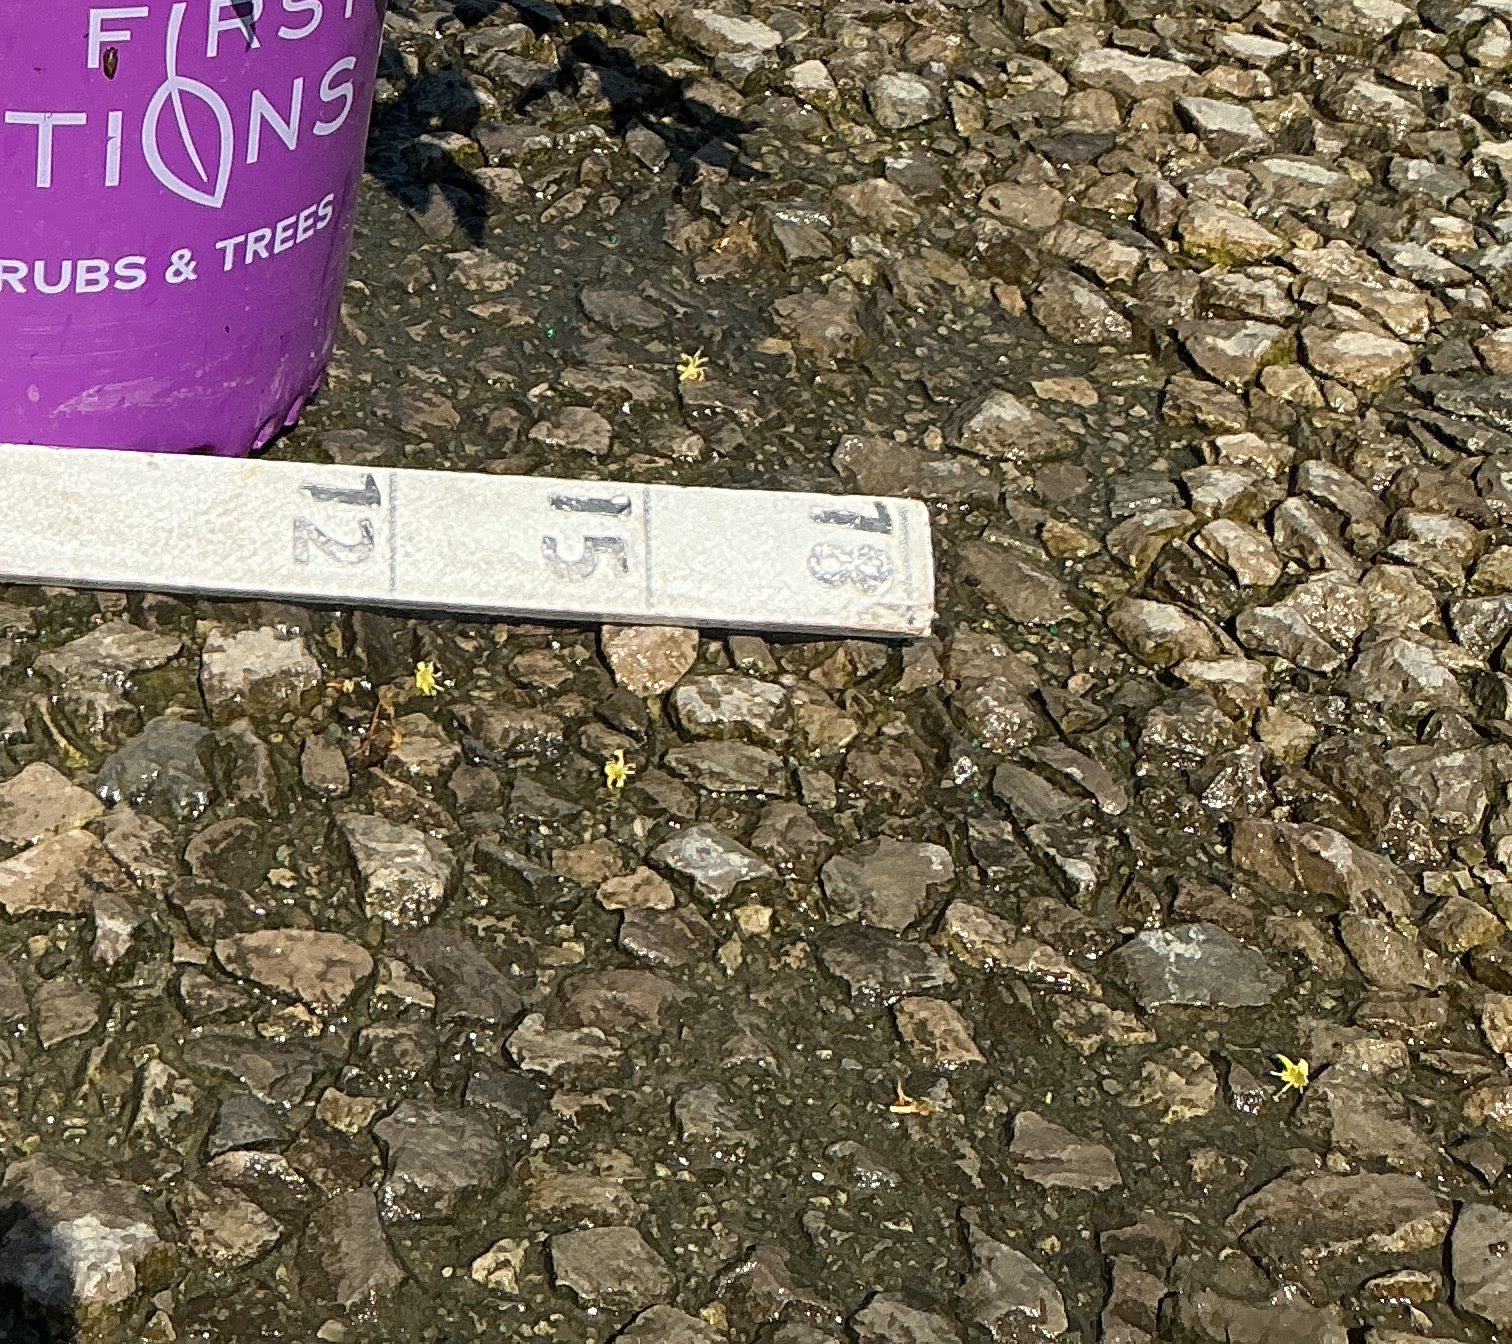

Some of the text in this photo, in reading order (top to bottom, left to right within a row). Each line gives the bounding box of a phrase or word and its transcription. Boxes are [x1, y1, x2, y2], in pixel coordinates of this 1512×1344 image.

[164, 248, 198, 285] &
[215, 192, 335, 273] TREES
[292, 472, 381, 564] 12
[542, 490, 632, 579] 15
[806, 500, 894, 597] 18
